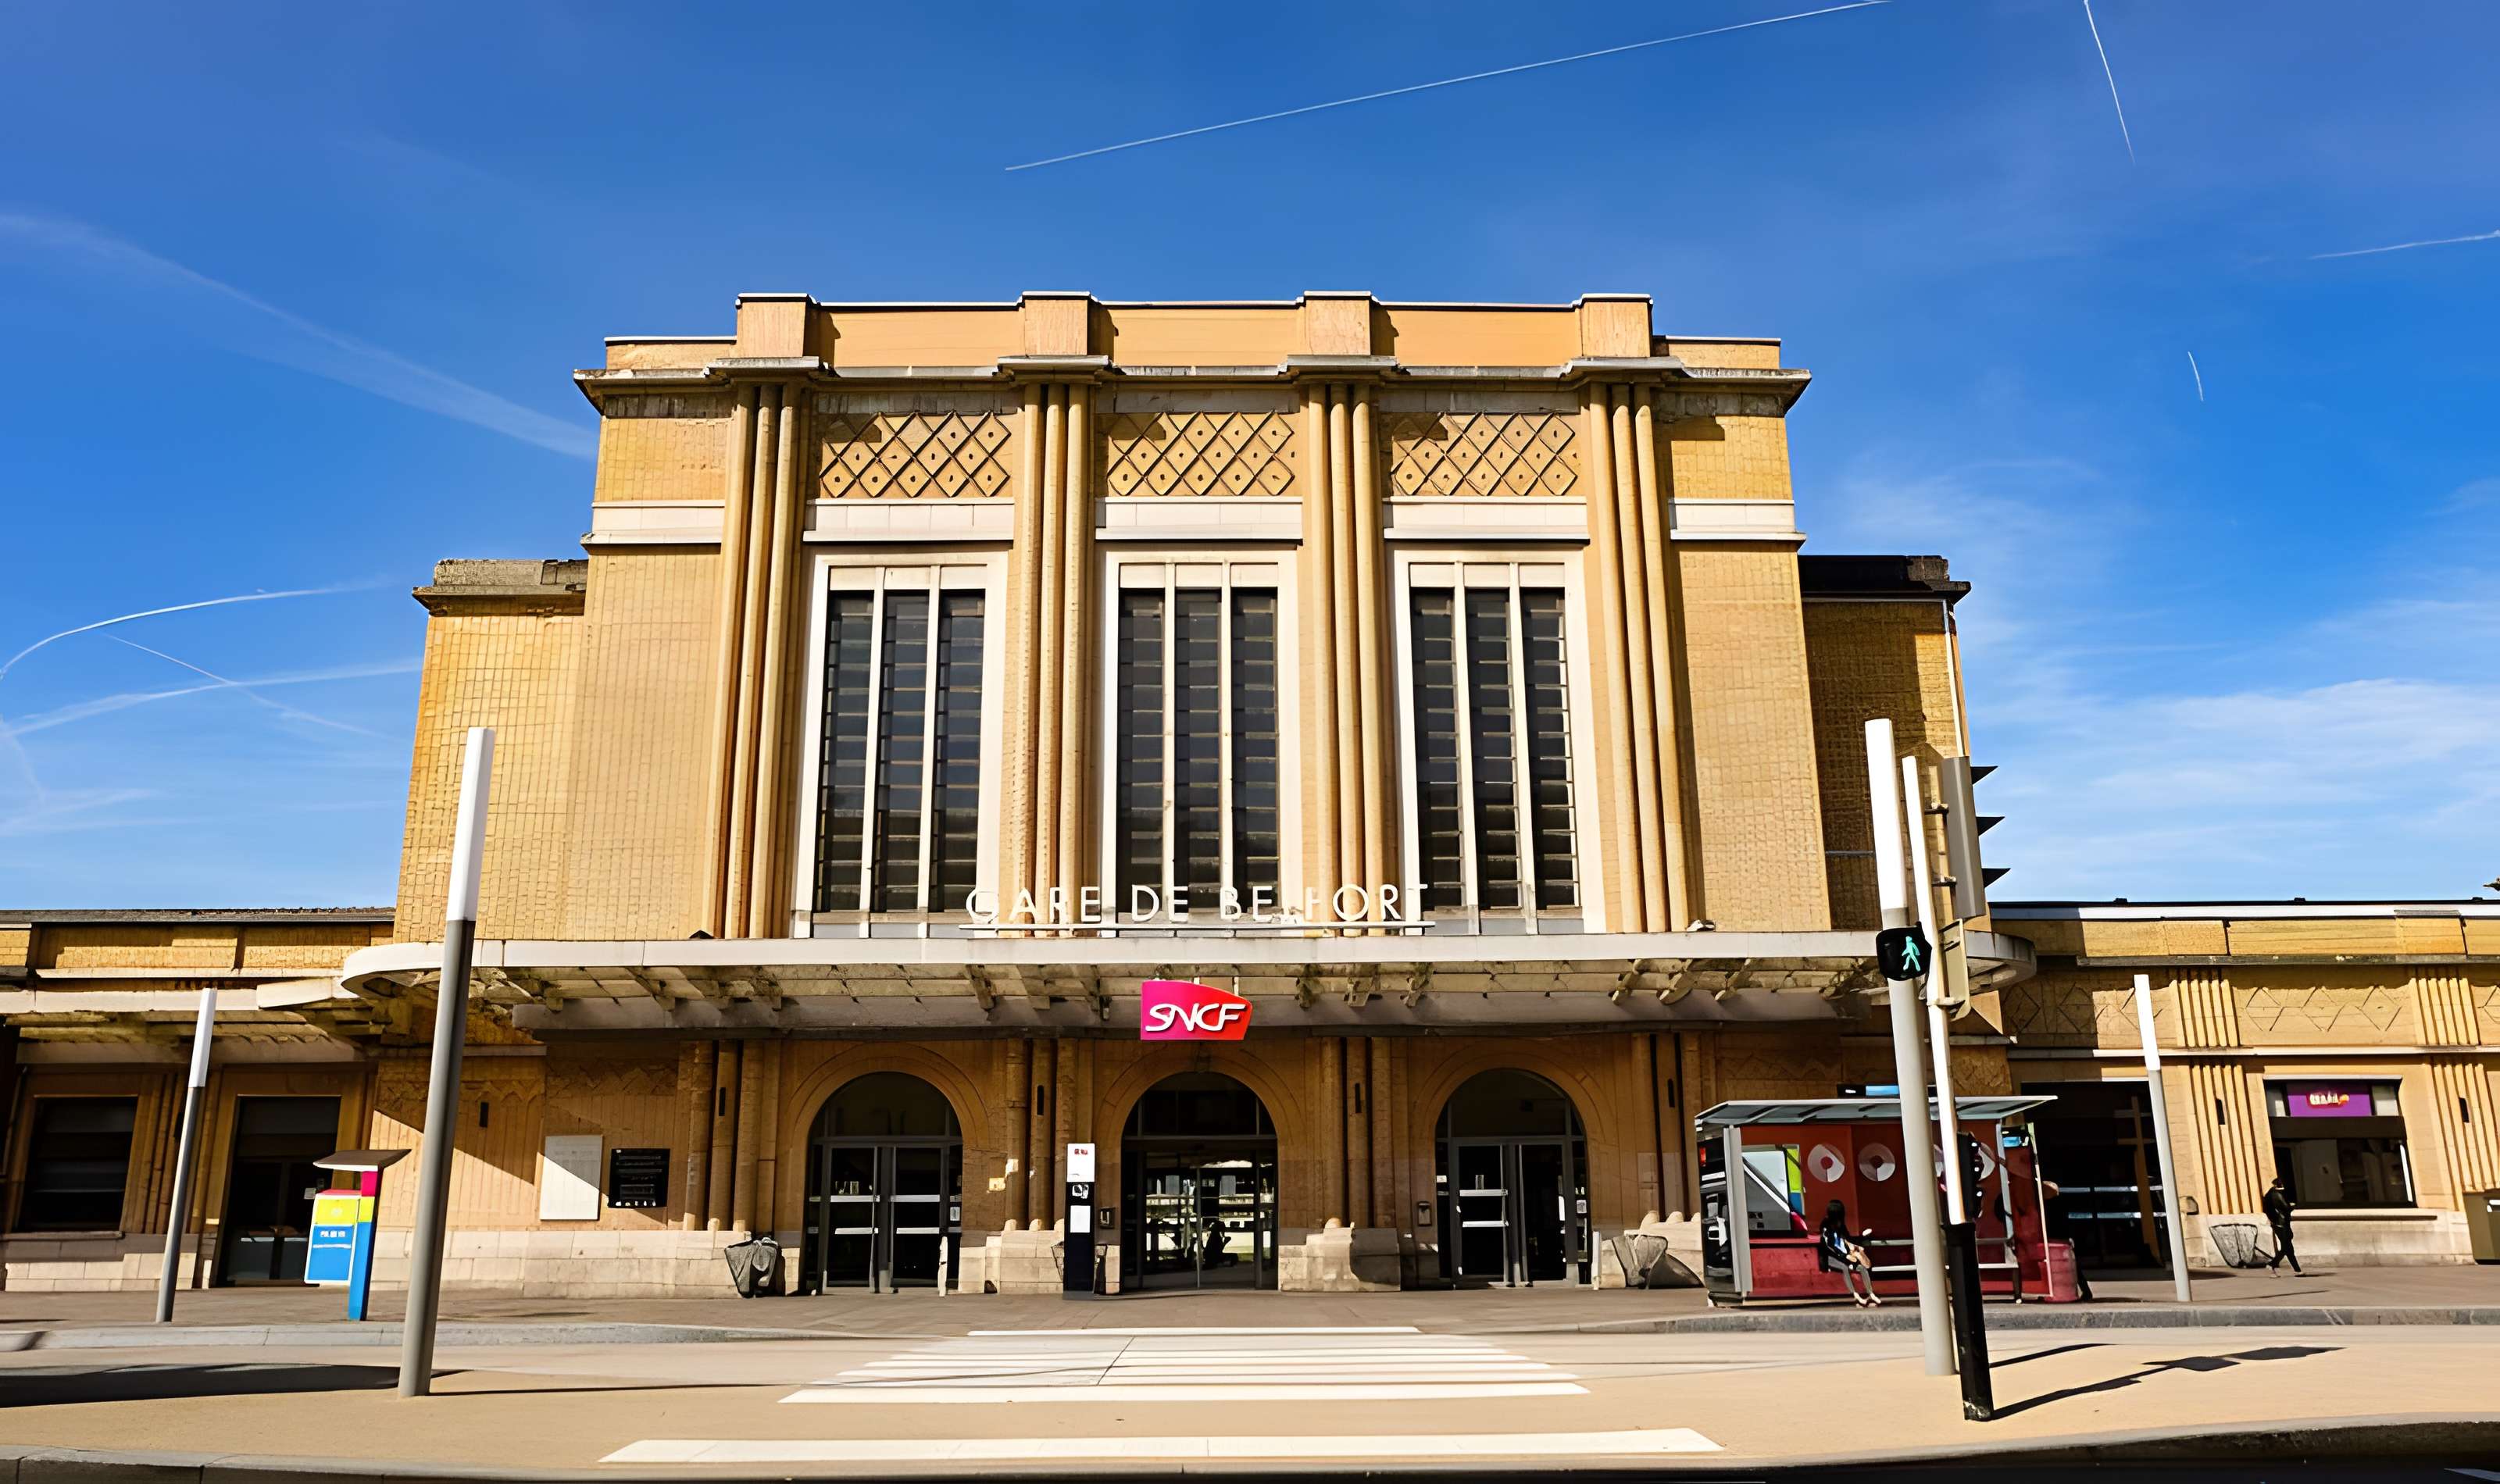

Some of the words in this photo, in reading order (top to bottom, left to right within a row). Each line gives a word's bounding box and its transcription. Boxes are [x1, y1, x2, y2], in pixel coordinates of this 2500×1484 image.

[966, 886, 1102, 923] GARE
[1131, 884, 1188, 922] DE
[1220, 883, 1429, 922] BEFORT
[1145, 1002, 1247, 1032] SNCF
